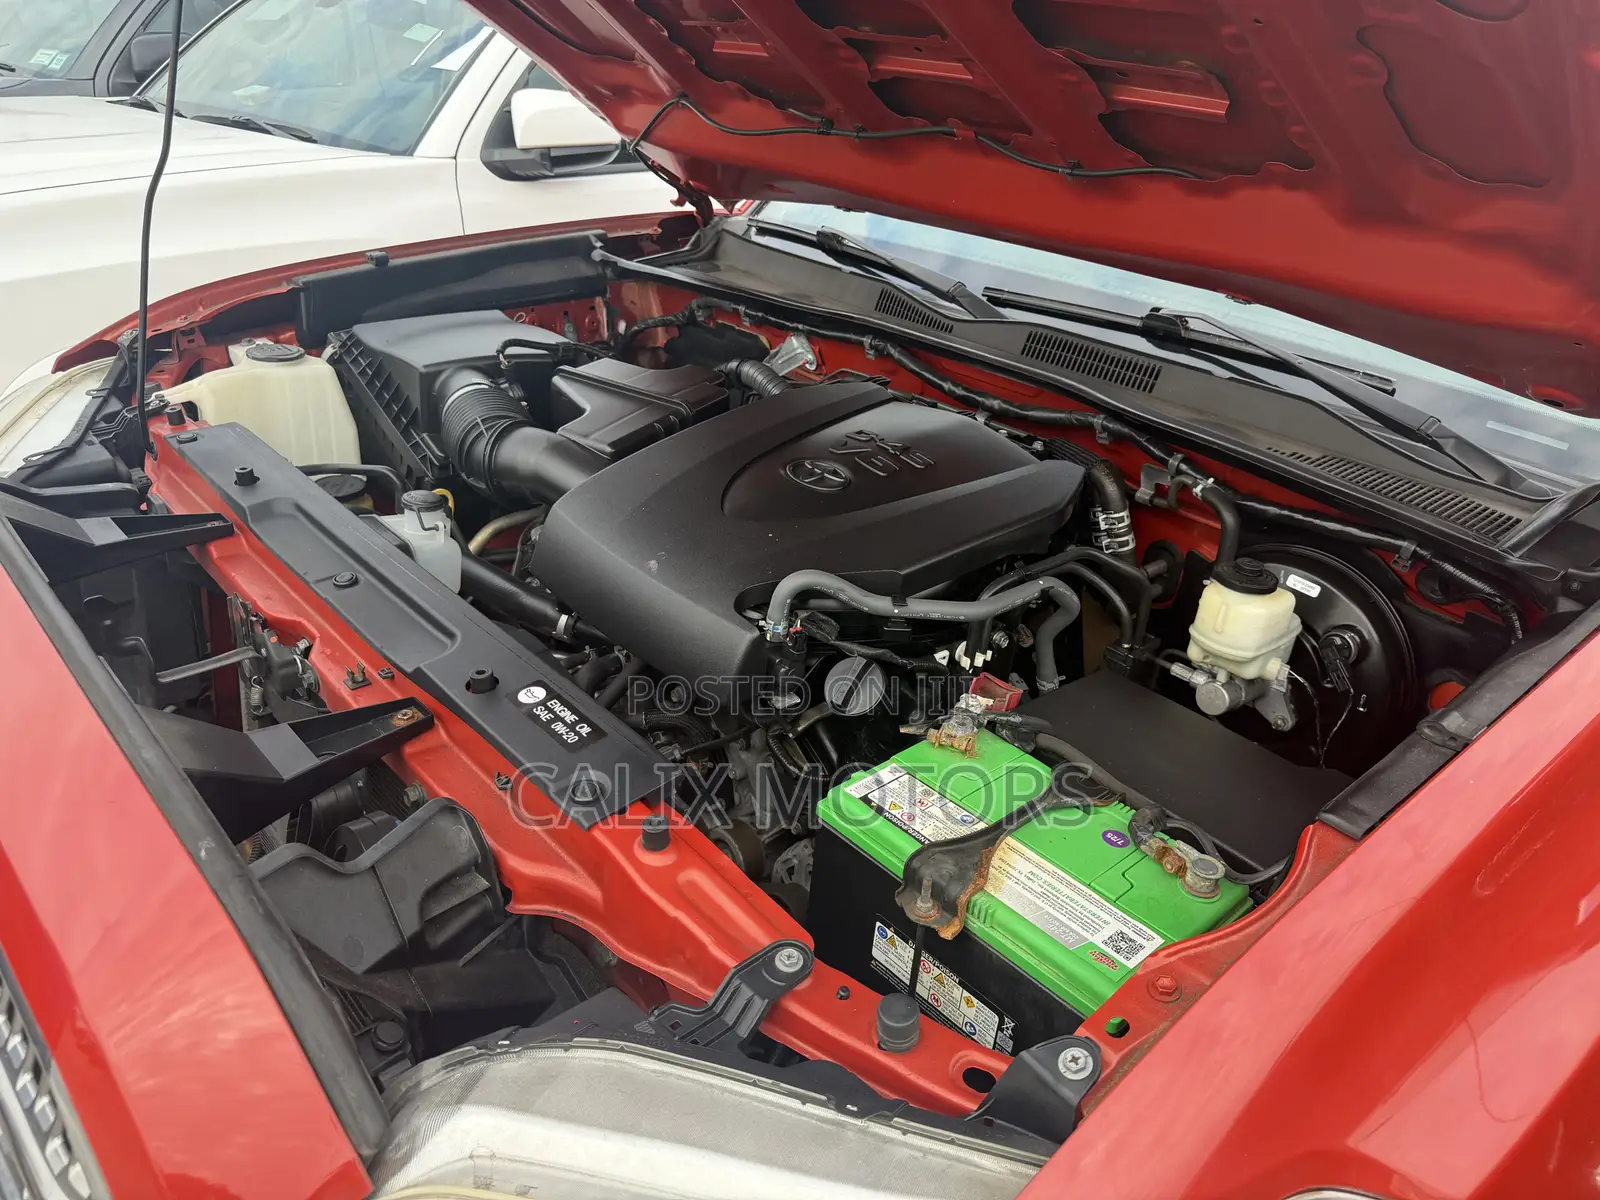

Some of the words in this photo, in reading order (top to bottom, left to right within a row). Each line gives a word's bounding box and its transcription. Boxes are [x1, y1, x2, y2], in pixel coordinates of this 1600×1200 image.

[532, 705, 555, 722] SAE
[551, 721, 579, 744] 0W-20
[546, 699, 579, 724] ENGINE
[575, 723, 593, 738] OIL
[883, 811, 930, 845] ANGER/POISON
